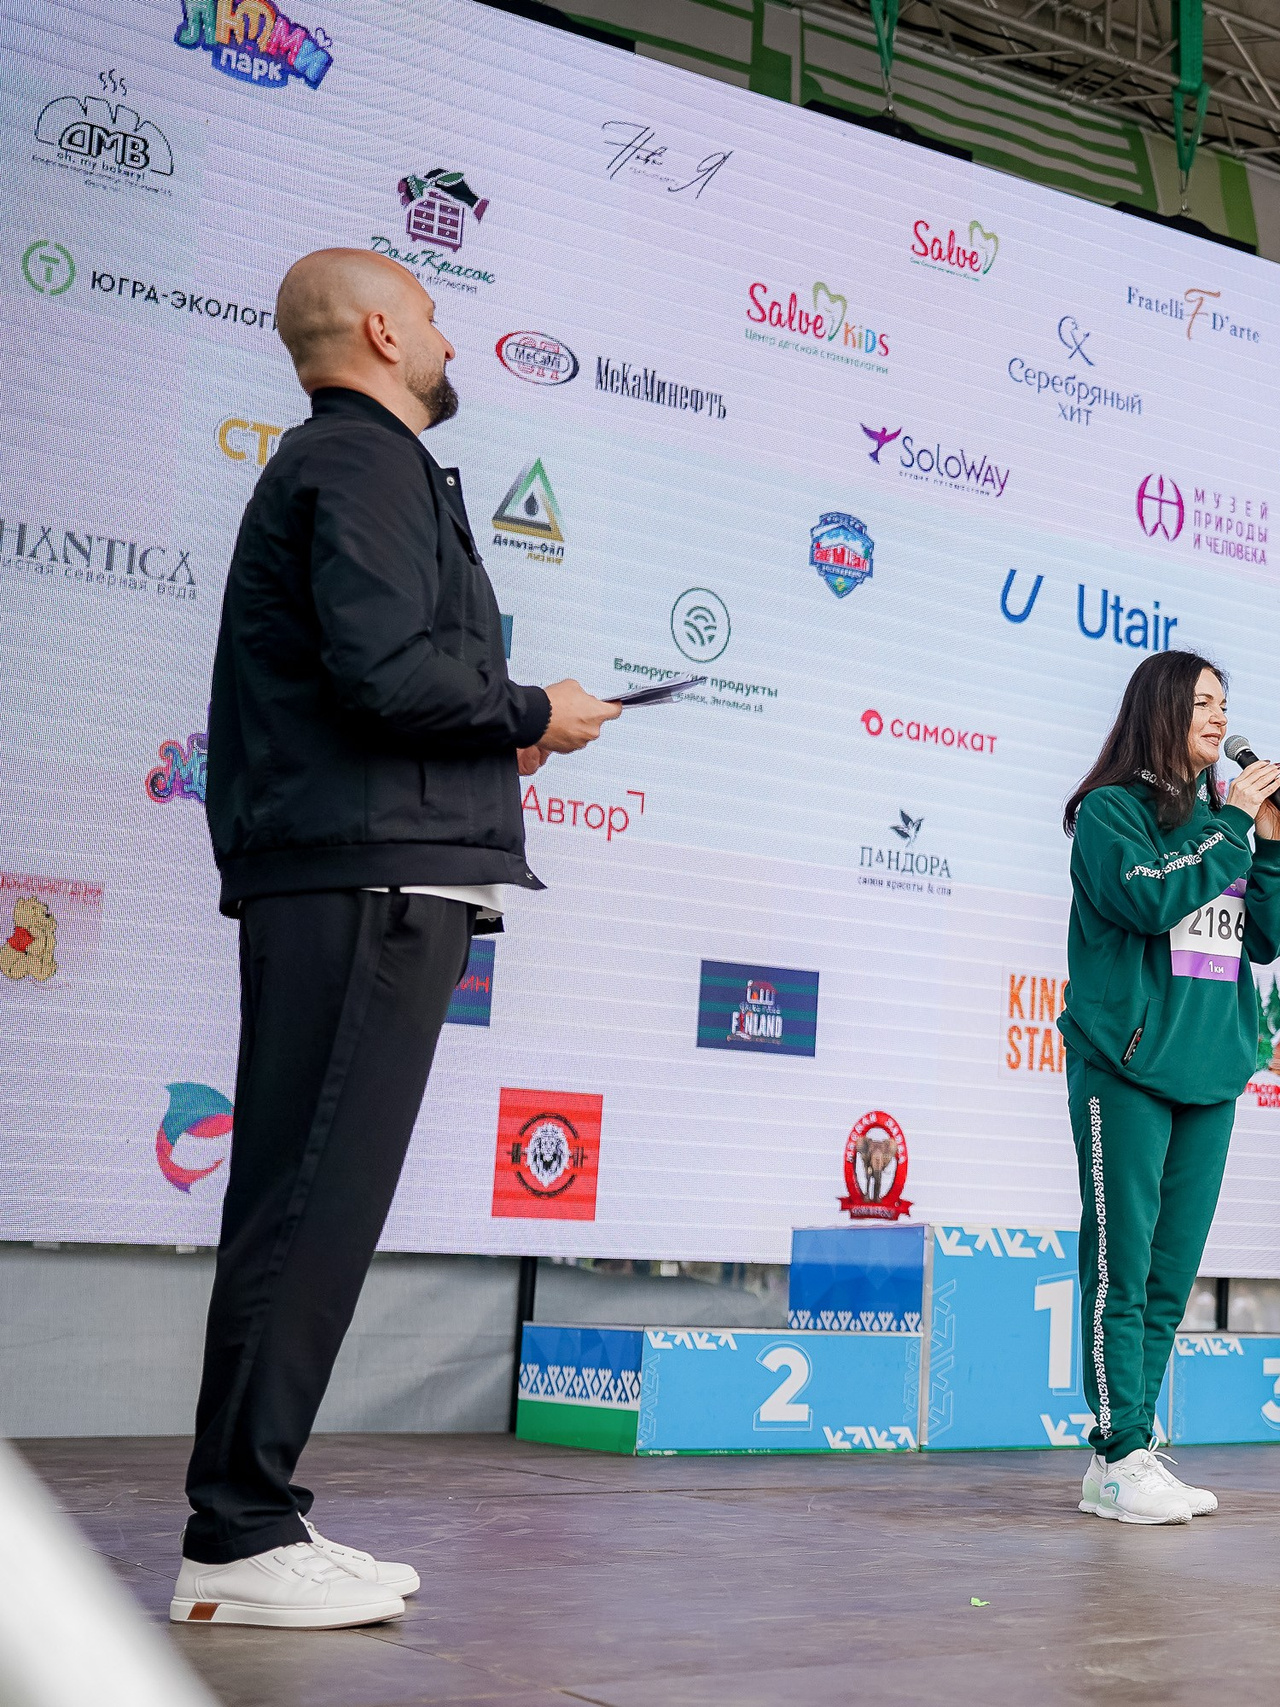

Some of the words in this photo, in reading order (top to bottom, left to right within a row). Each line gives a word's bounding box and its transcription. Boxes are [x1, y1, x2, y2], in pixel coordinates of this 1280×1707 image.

[911, 220, 982, 273] Salve
[747, 282, 827, 339] Salve
[1128, 286, 1184, 320] Fratelli
[1008, 357, 1143, 415] Серебряный
[1194, 487, 1269, 521] МУЗЕЙ
[1193, 510, 1268, 543] ПРИРОДЫ
[1205, 535, 1268, 566] ЧЕЛОВЕКА
[1077, 583, 1178, 651] Utair
[711, 677, 778, 699] продукты
[890, 718, 998, 754] самокат
[522, 784, 630, 842] Автор
[1188, 906, 1245, 942] 2186
[1034, 1279, 1074, 1389] 1
[759, 1347, 810, 1423] 2
